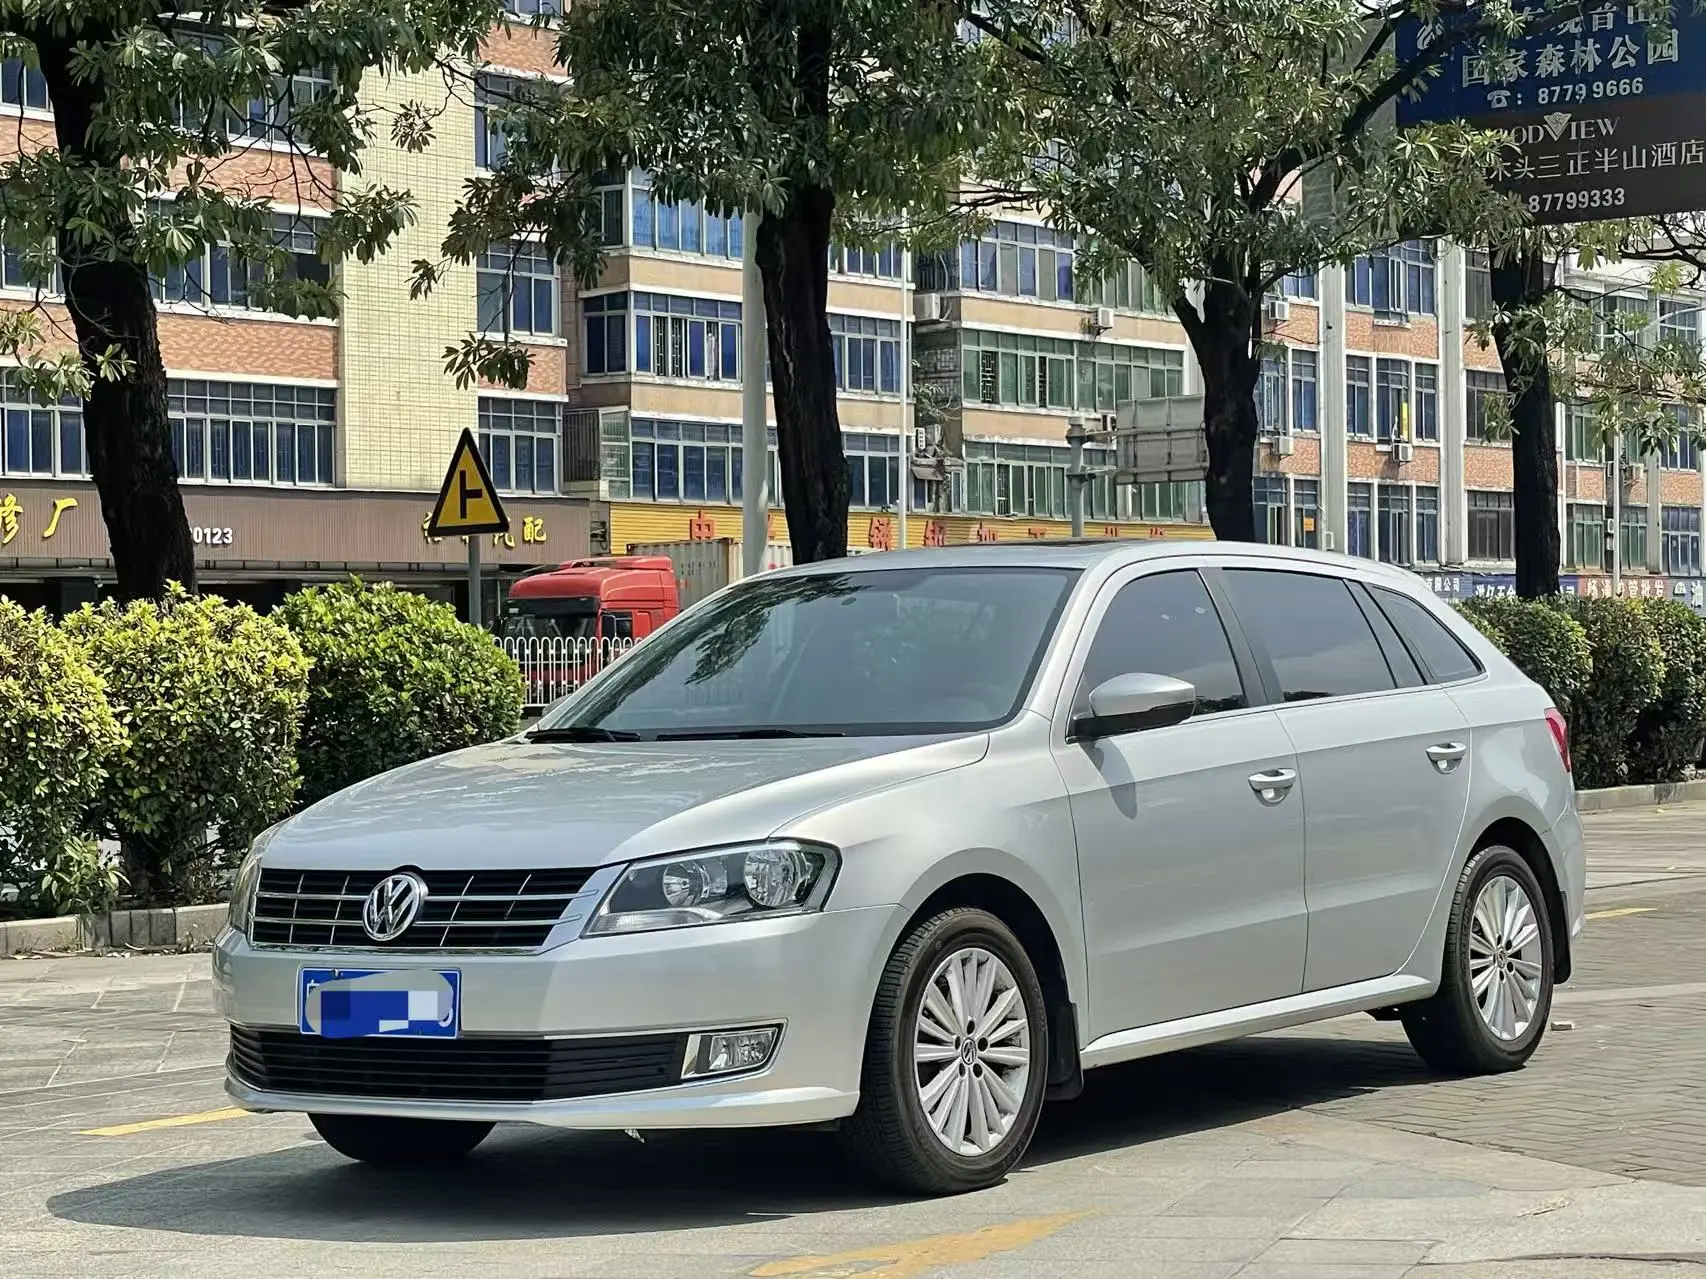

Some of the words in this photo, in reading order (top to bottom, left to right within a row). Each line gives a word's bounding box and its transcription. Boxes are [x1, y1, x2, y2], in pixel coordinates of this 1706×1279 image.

[1537, 83, 1587, 105] 8779
[1592, 76, 1645, 99] 9666
[1528, 187, 1626, 213] 87799333
[190, 527, 233, 544] 0123
